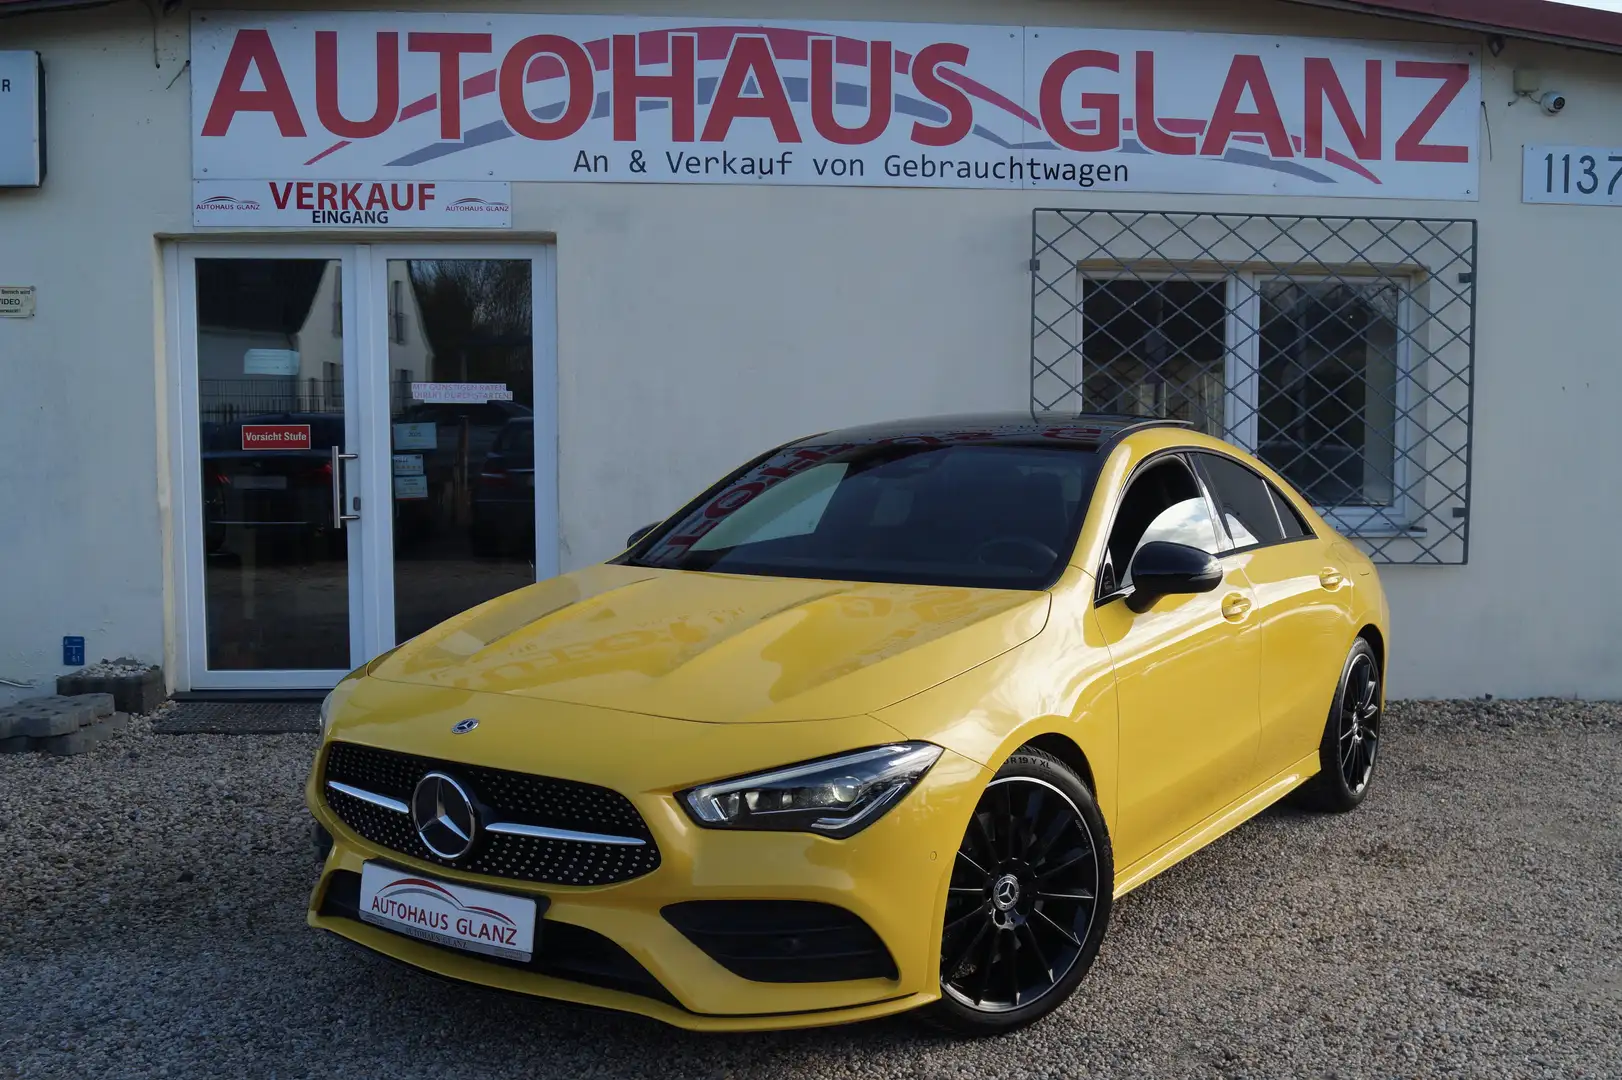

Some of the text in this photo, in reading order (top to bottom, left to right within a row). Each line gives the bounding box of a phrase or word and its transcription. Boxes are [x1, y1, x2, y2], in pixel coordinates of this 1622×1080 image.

[201, 29, 1470, 163] AUTOHAUS GLANZ
[573, 149, 1129, 188] An & Verkauf von Gebrauchtwagen
[268, 182, 436, 211] VERKAUF
[312, 210, 389, 224] EINGANG
[245, 431, 307, 441] Vorsicht Stufe
[371, 896, 518, 946] AUTOHAUS GLANZ
